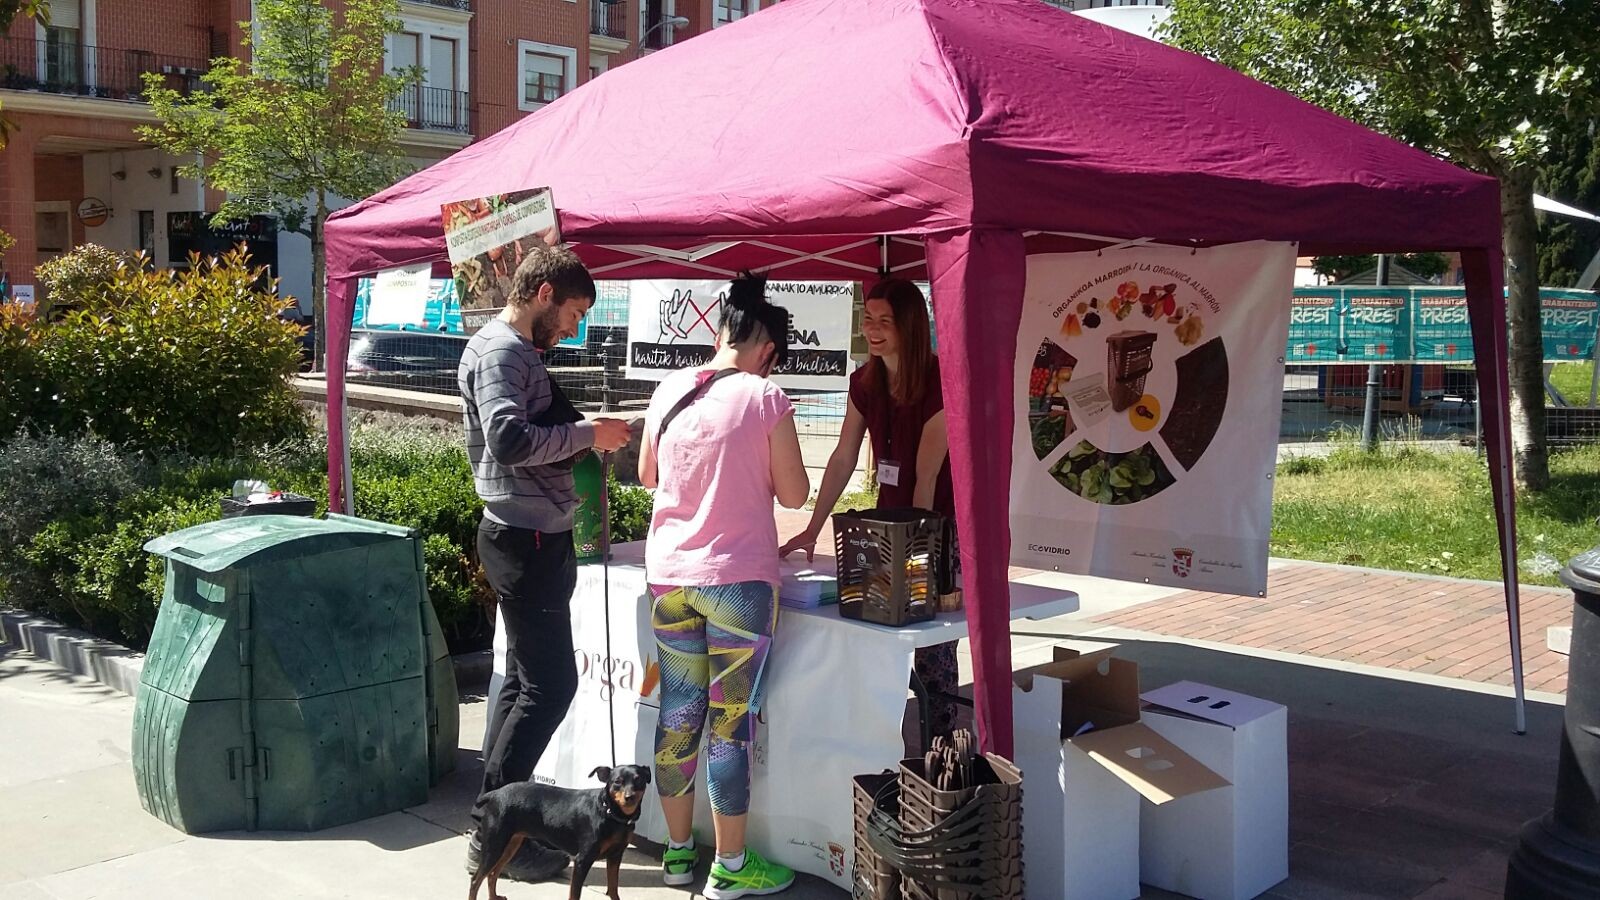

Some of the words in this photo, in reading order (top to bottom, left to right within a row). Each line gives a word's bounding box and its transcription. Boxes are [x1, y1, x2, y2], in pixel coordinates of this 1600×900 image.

[764, 282, 795, 294] KAINAK
[796, 283, 806, 294] 10
[1052, 281, 1094, 319] ORGANIKOA
[1139, 263, 1151, 272] LA
[1189, 280, 1201, 291] AL
[1290, 306, 1335, 325] REST
[1350, 306, 1405, 325] PREST
[1540, 308, 1598, 327] PREST
